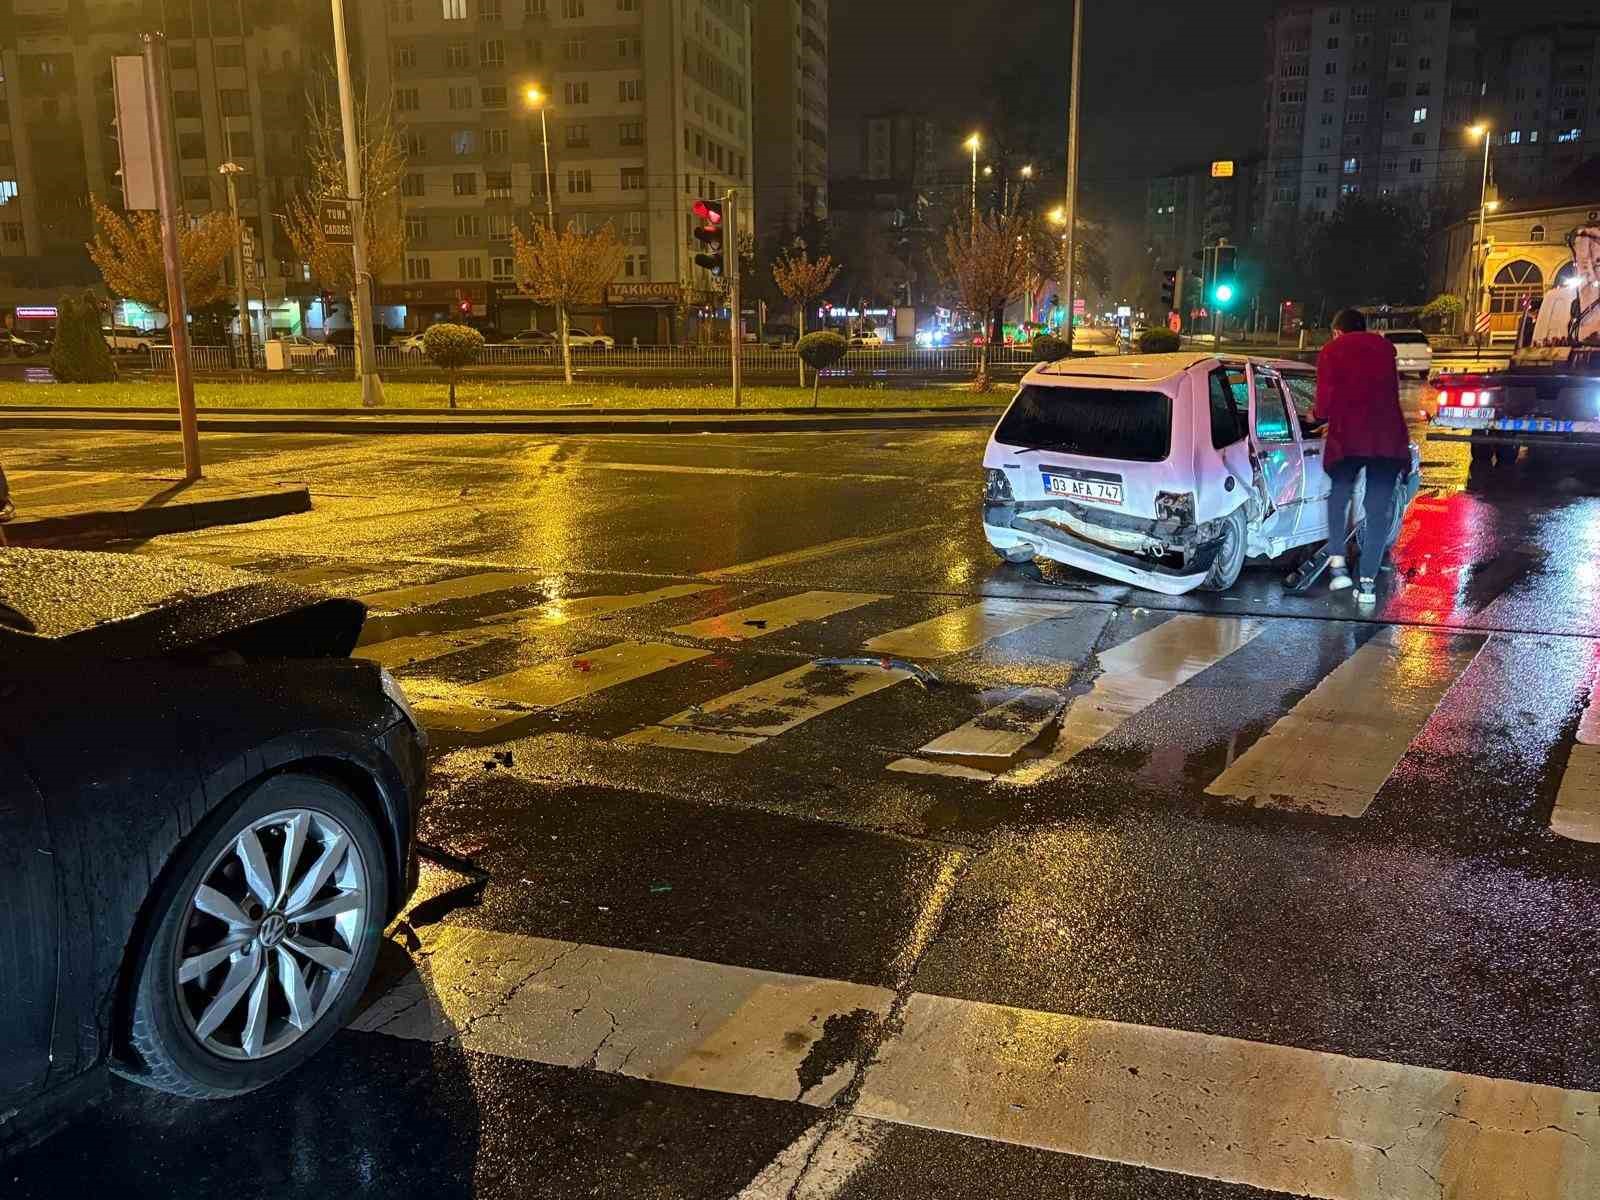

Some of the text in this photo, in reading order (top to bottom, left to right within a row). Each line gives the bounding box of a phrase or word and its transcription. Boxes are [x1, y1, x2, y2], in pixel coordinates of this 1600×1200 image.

[326, 208, 347, 220] TUNA
[1052, 478, 1066, 491] 03
[1072, 482, 1092, 496] AFA
[1098, 484, 1119, 499] 747
